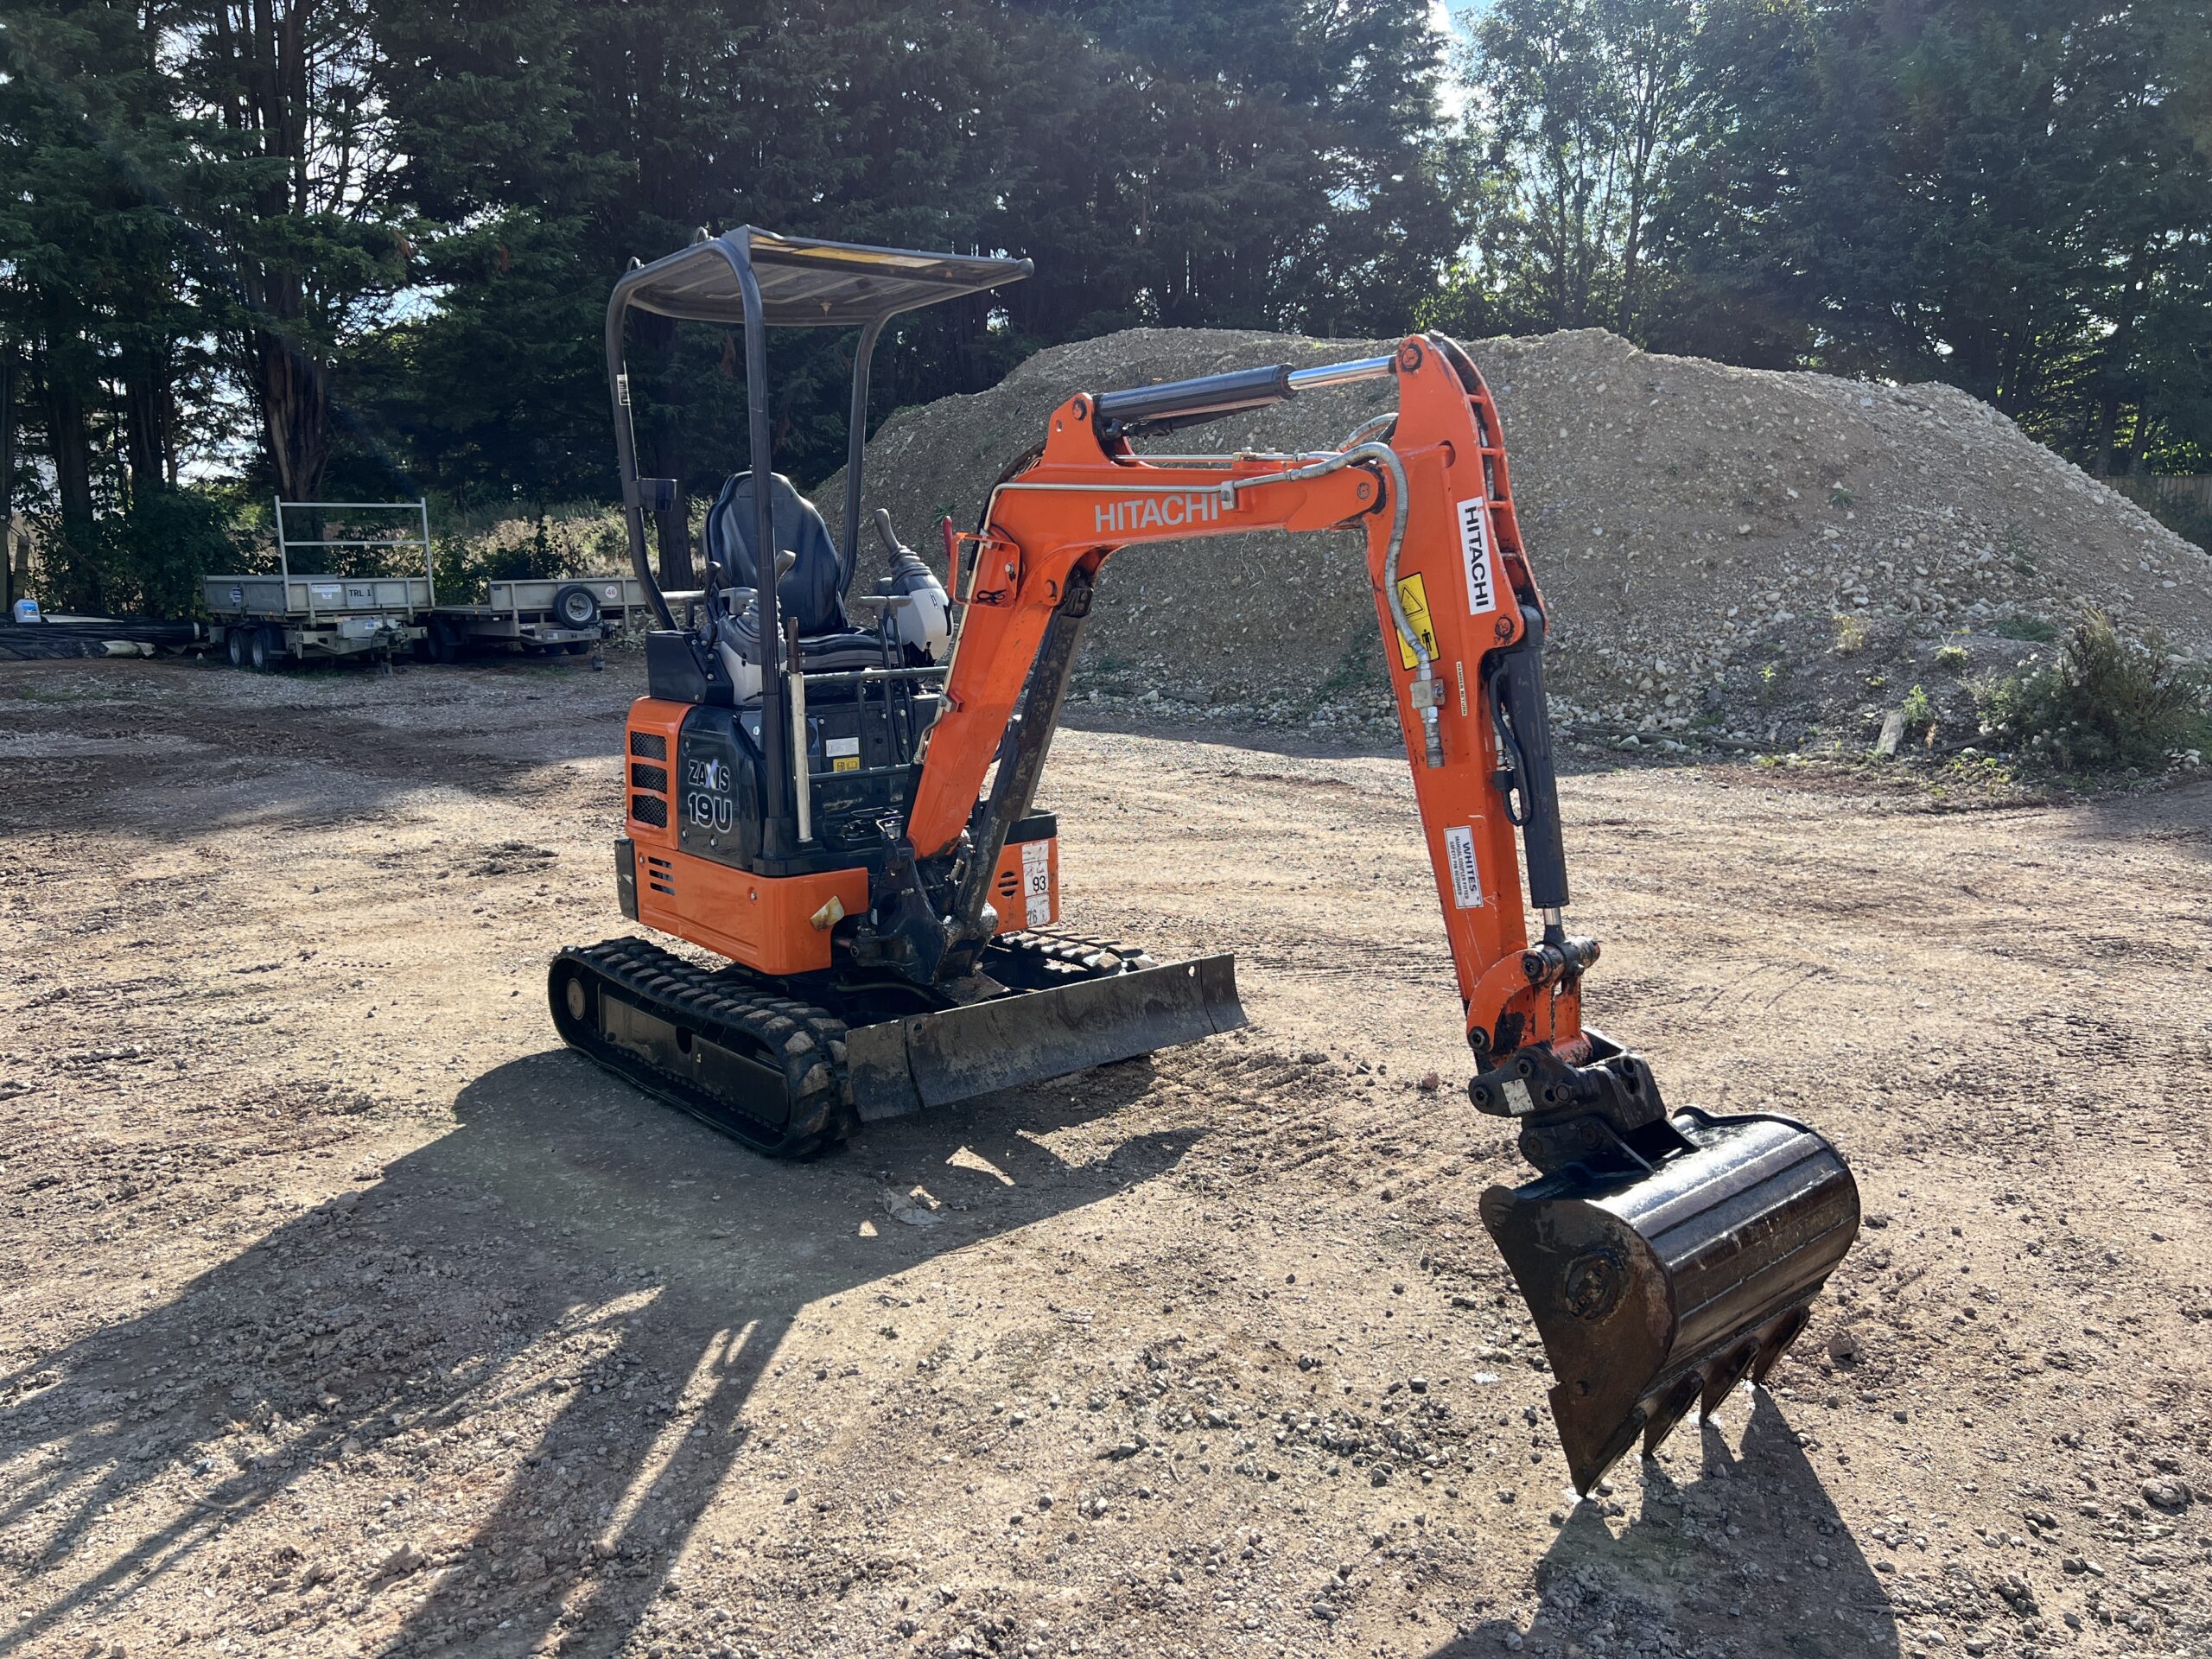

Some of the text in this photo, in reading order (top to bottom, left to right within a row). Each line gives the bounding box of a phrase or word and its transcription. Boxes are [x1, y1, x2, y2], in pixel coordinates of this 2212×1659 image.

[1095, 493, 1217, 532] HITACHI
[1465, 506, 1489, 607] HITACHI
[689, 759, 730, 793] ZAXIS
[688, 792, 733, 834] 19U
[1033, 875, 1046, 892] 93
[1463, 842, 1478, 892] WHITES
